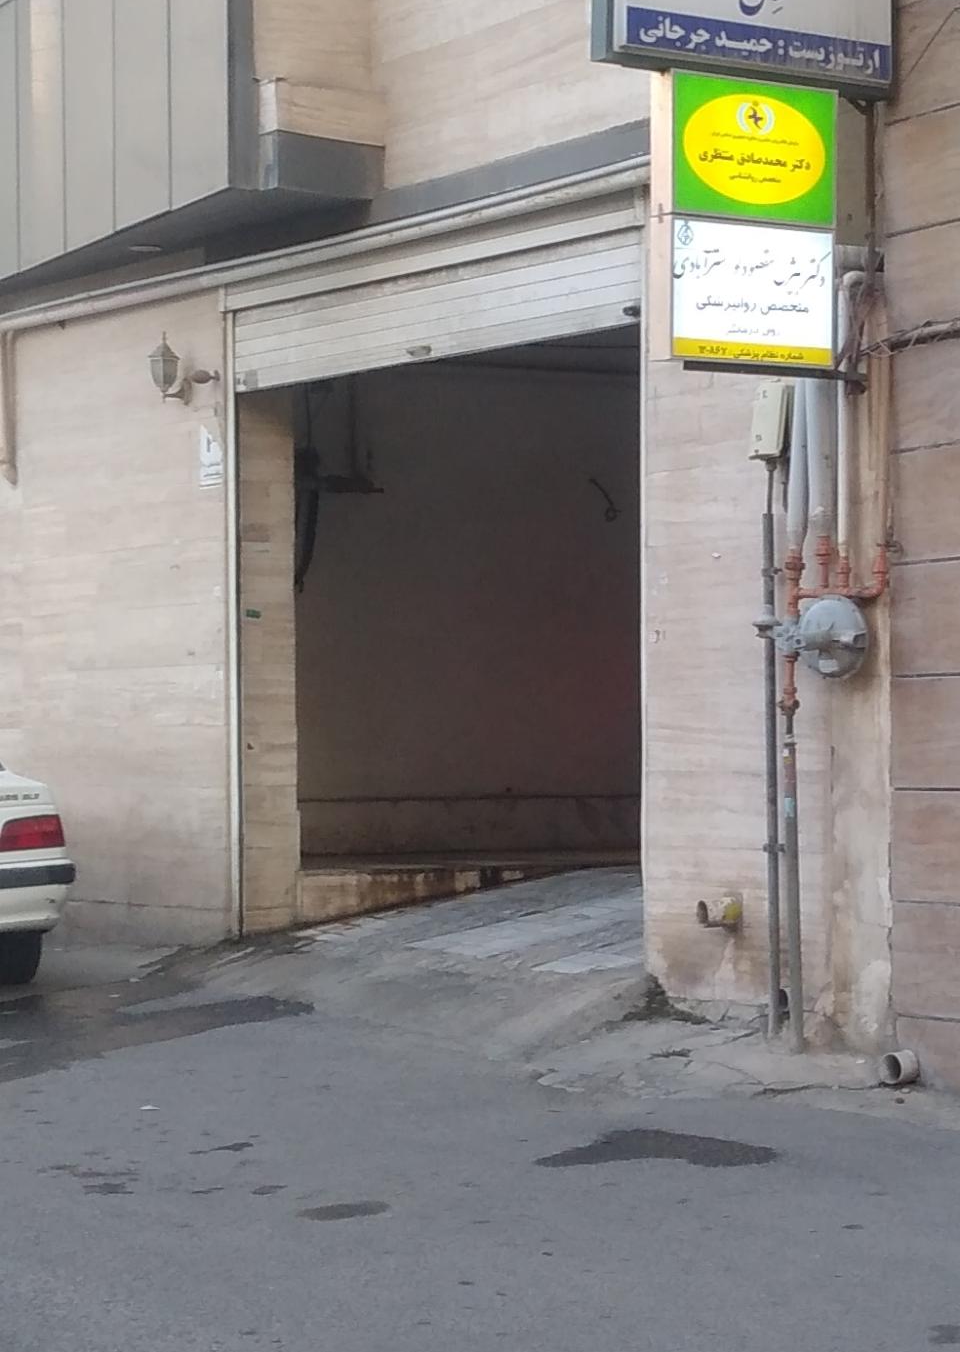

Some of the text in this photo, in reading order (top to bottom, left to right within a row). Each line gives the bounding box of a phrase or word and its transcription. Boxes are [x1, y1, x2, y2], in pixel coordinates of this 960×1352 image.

[639, 16, 711, 48] جرجانی
[715, 27, 773, 54] حمید
[789, 41, 881, 75] ارتوزیست
[790, 157, 811, 173] دکتر
[800, 251, 832, 290] دکتر
[760, 303, 810, 315] متخصص
[733, 348, 760, 360] پزشکی
[780, 351, 804, 361] شماره
